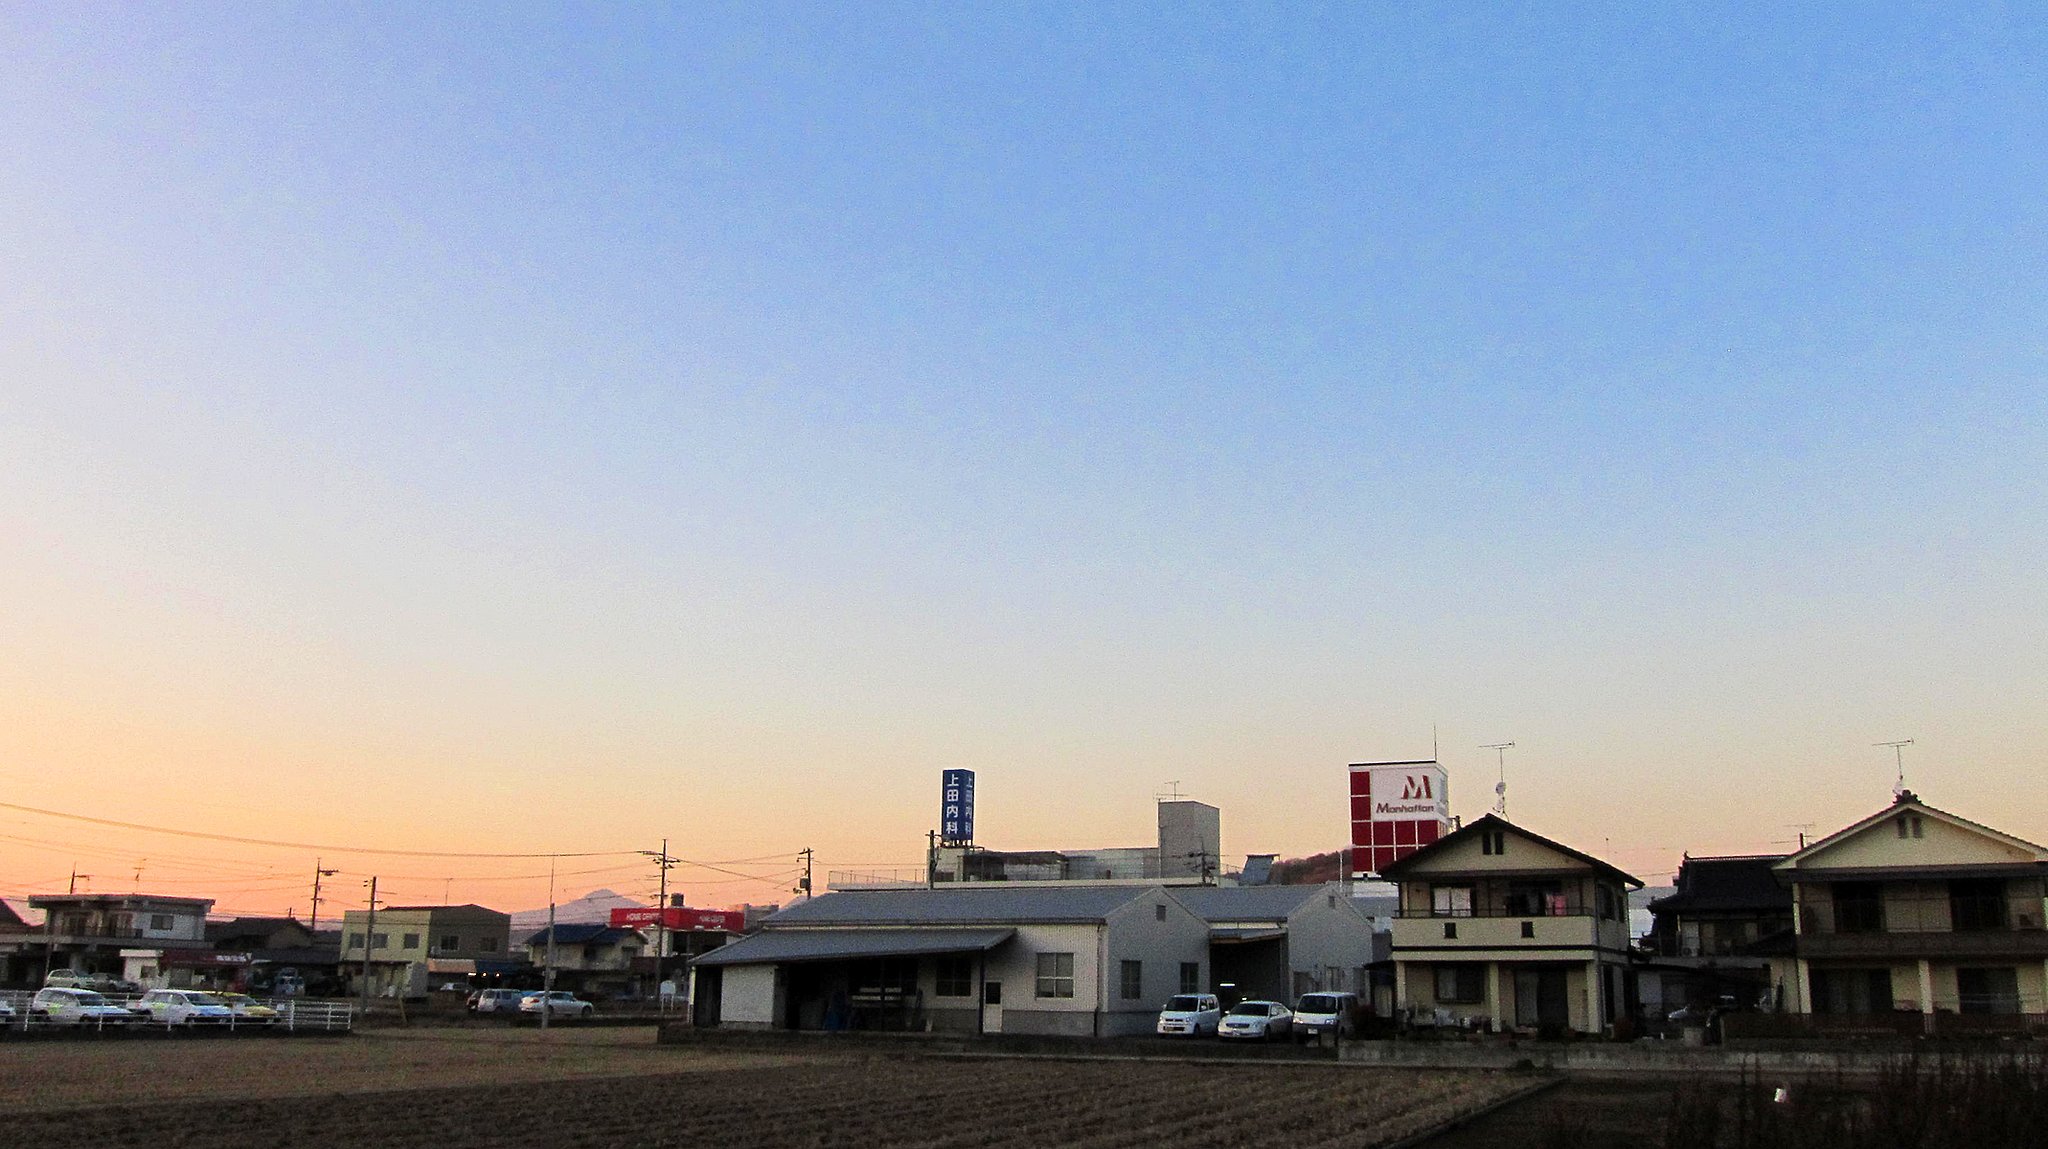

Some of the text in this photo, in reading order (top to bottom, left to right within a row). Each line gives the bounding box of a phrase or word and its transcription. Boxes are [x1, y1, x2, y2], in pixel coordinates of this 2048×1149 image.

[946, 773, 959, 834] 上田内科
[1376, 803, 1434, 813] Manhattan
